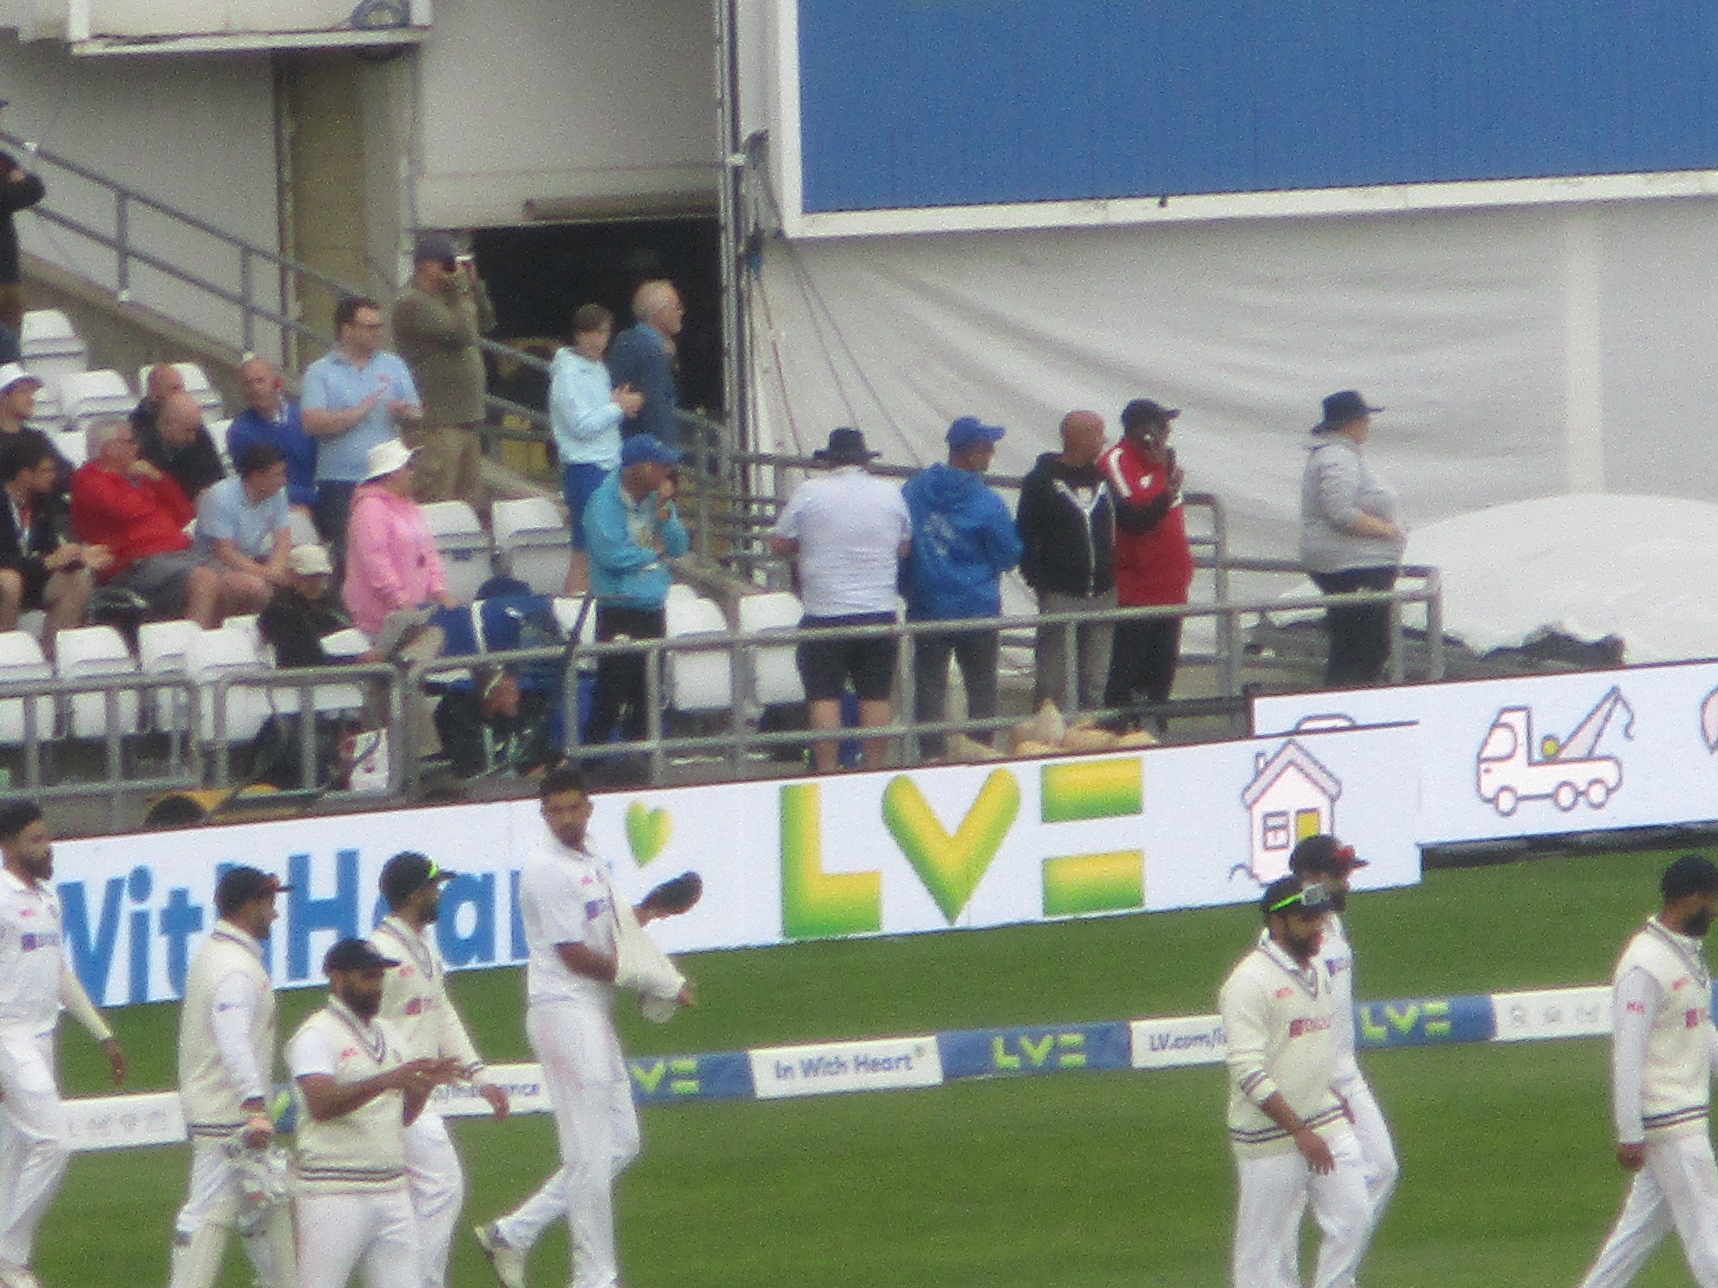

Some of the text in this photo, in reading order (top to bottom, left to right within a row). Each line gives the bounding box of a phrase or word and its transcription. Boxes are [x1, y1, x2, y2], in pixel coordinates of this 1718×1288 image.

[774, 1054, 914, 1080] In With Heart
